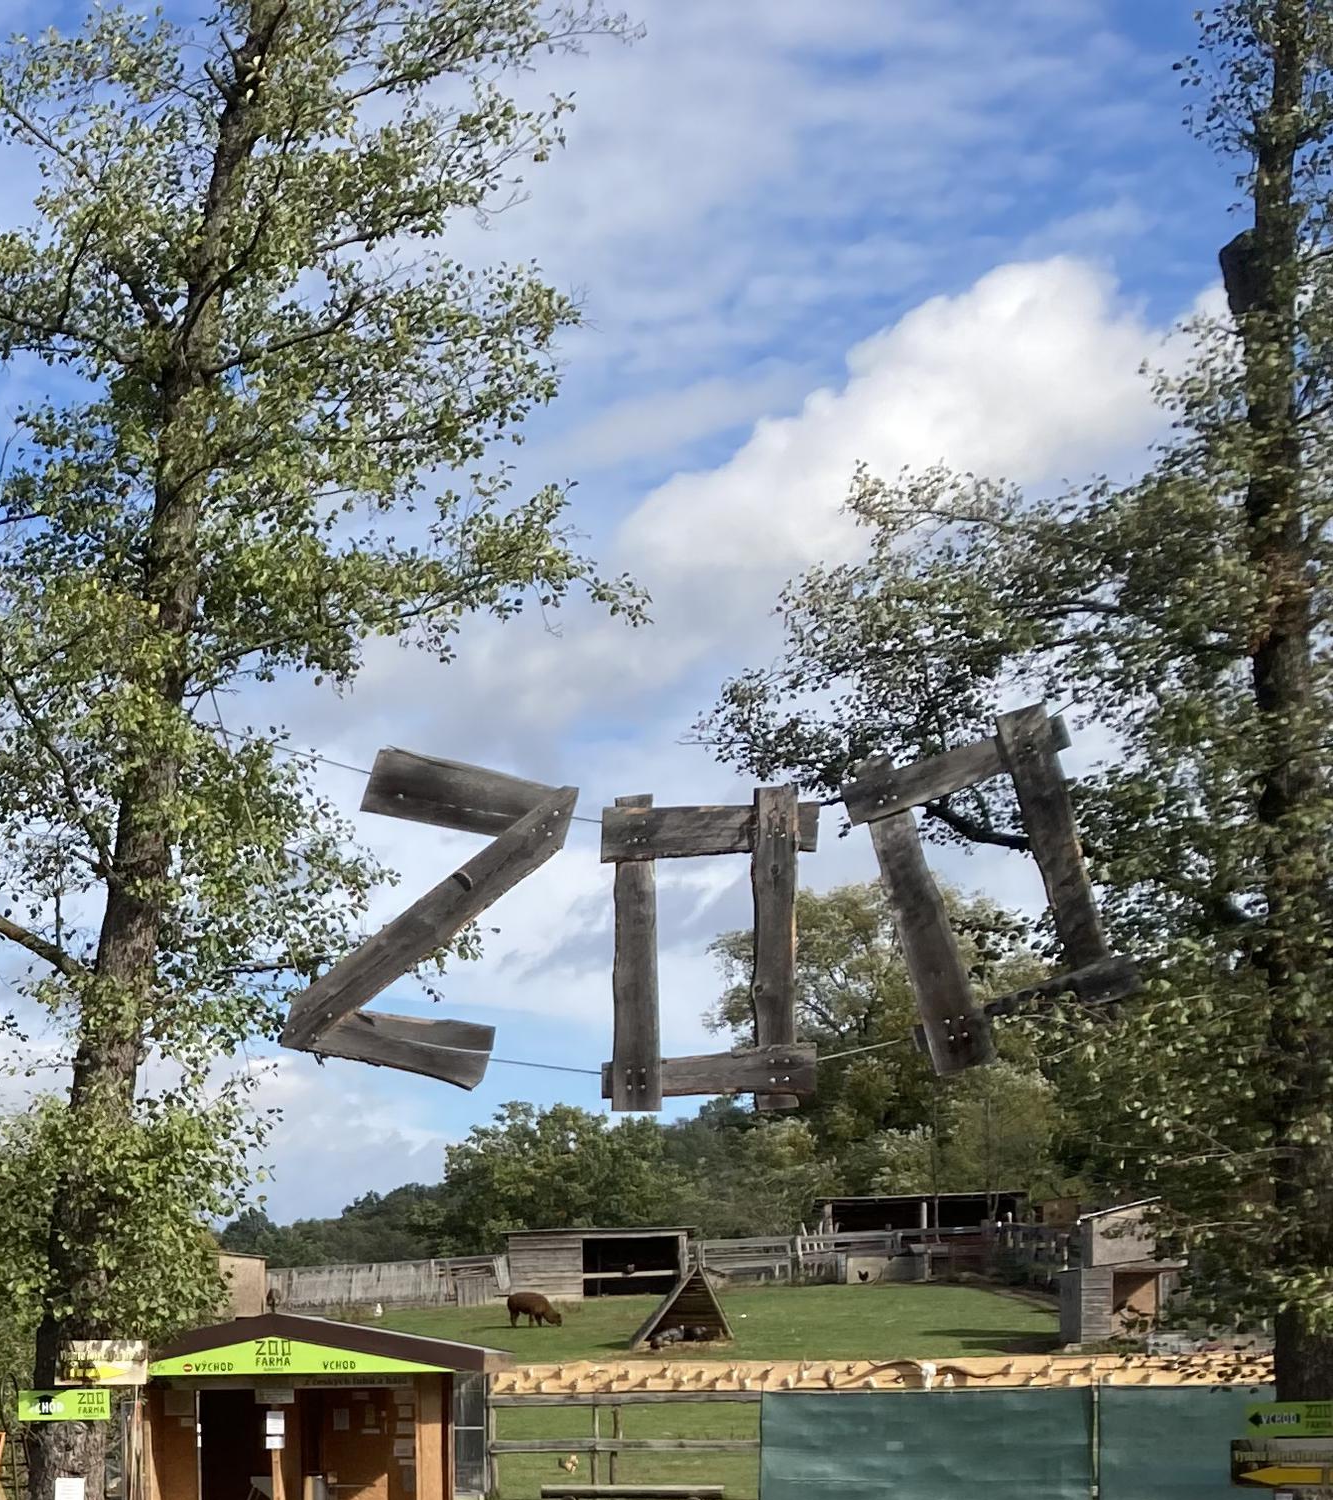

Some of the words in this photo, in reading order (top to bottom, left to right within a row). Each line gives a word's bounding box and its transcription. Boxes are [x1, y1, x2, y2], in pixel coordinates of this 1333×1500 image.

[281, 703, 1135, 1111] ZOO
[255, 1340, 291, 1356] ZOO
[195, 1361, 234, 1372] VÝCHOD
[255, 1357, 291, 1367] FARMA
[322, 1360, 356, 1370] VCHOD
[77, 1391, 104, 1404] ZOO
[77, 1406, 106, 1414] FARMA
[1261, 1413, 1297, 1424] VCHOD
